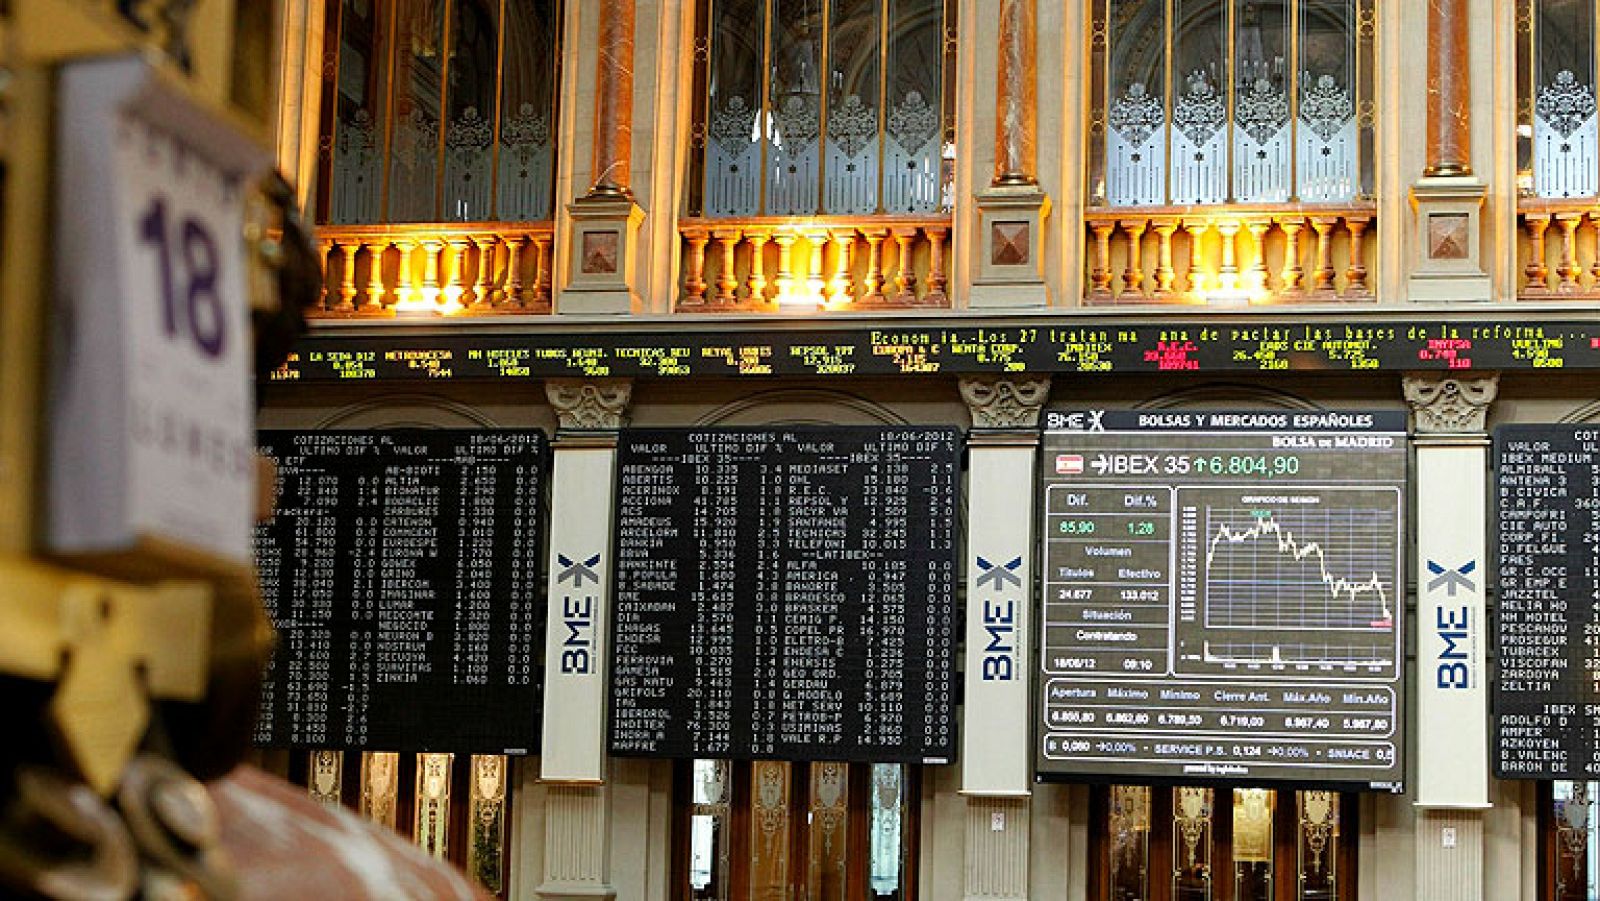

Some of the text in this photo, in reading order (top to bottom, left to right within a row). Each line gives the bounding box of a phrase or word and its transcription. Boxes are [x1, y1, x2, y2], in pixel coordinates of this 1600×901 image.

[138, 198, 227, 359] 18
[1020, 329, 1037, 342] 27
[1199, 327, 1218, 341] de
[1232, 326, 1290, 341] pactar
[1305, 325, 1332, 340] las
[1345, 324, 1395, 340] bases
[1407, 325, 1426, 340] de
[1441, 324, 1459, 339] la
[1472, 324, 1545, 339] reforma
[1047, 412, 1084, 429] BME
[1139, 412, 1374, 428] BOLSAS Y MERCADOS ESPAÑOLES
[1272, 436, 1317, 448] BOLSA
[1334, 436, 1394, 448] MADRID
[1508, 441, 1551, 451] VALOR
[1541, 453, 1593, 464] MEDIUM
[1108, 454, 1300, 477] IBEX 35 6.804,90
[1501, 464, 1567, 474] ALMIRALL
[1067, 494, 1089, 506] Dif.
[1127, 522, 1155, 536] 1.28
[1533, 522, 1568, 531] AUTO
[1084, 545, 1132, 557] Volumen
[1117, 567, 1161, 579] Efectivo
[1524, 612, 1568, 622] HOTEL
[561, 595, 592, 675] BME
[982, 600, 1013, 681] BME
[1436, 605, 1469, 689] BME
[1501, 681, 1551, 691] ZELTIA
[1051, 687, 1097, 700] Apertura
[1501, 715, 1551, 725] ADOLFO
[1154, 743, 1203, 756] SERVICE
